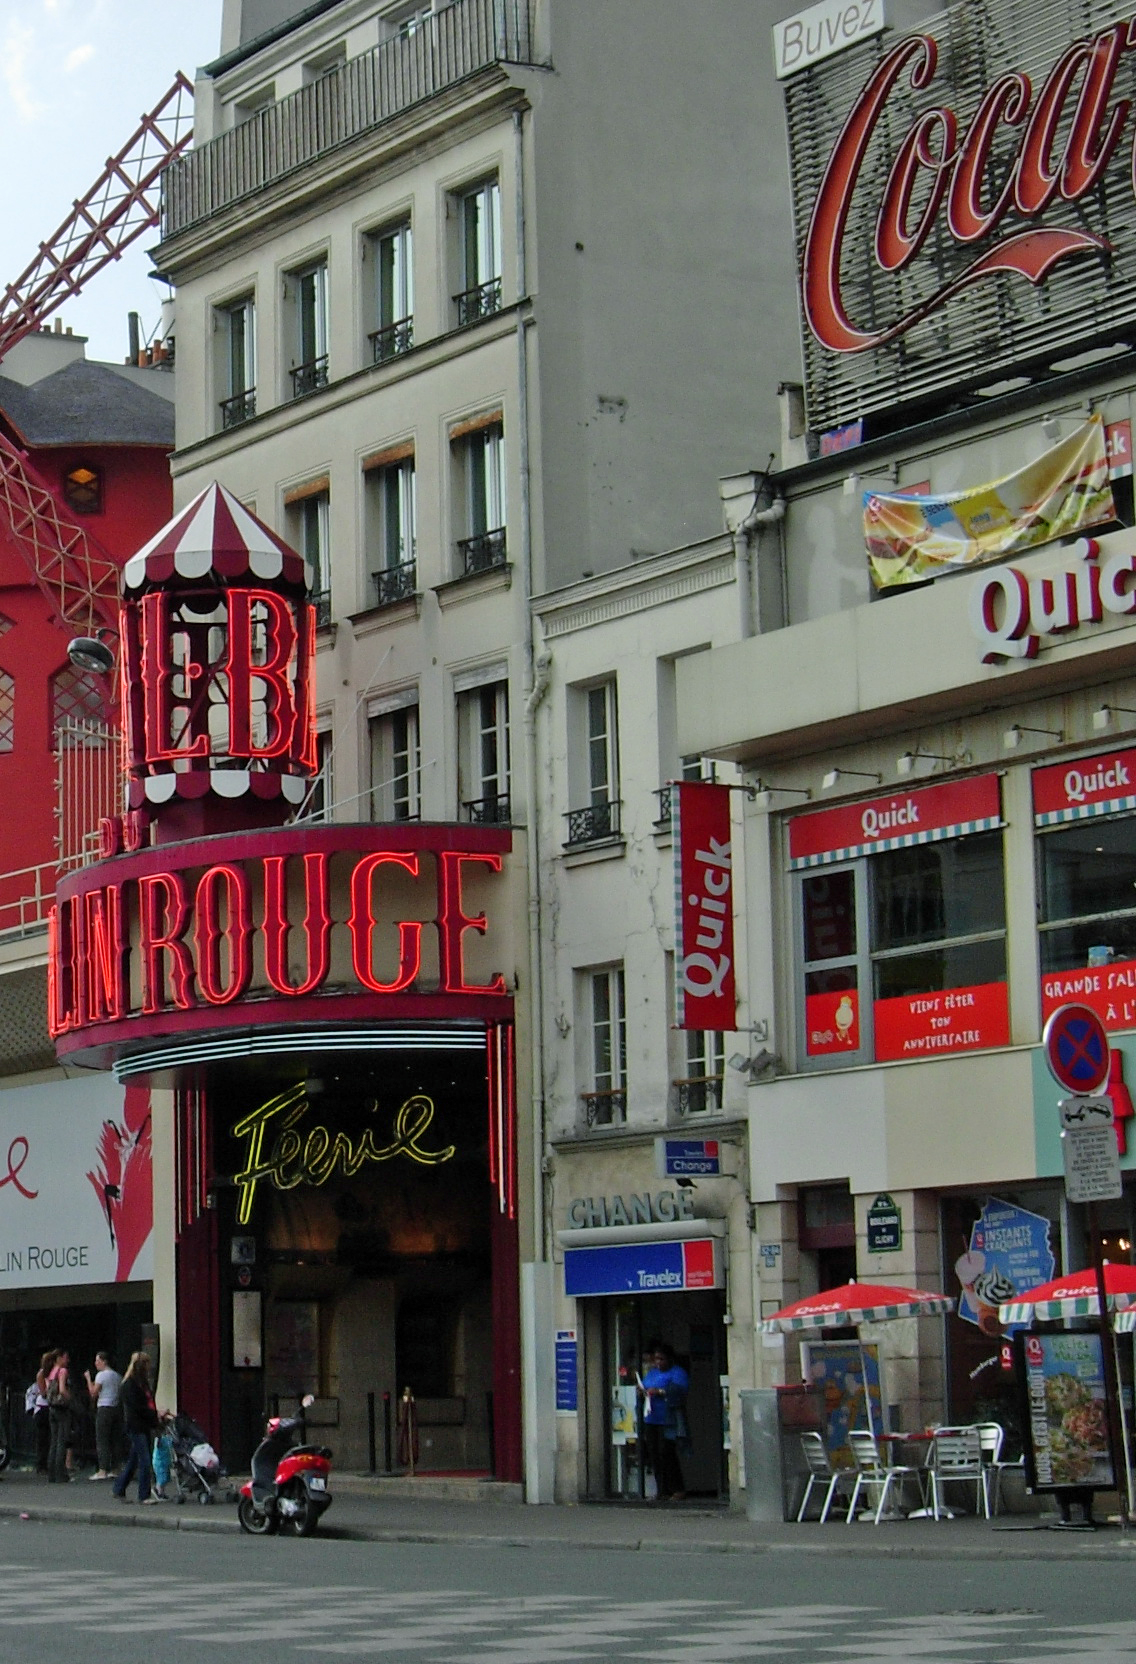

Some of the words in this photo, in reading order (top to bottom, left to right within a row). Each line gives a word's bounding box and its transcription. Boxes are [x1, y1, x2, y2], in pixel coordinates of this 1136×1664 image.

[781, 0, 876, 69] Buvez
[1064, 760, 1130, 802] Quick
[861, 799, 919, 838] Quick
[682, 836, 732, 998] Quick
[139, 851, 506, 1012] ROUGE
[1045, 975, 1100, 998] GRANDE
[910, 997, 942, 1014] VIENS
[931, 1016, 951, 1029] TON
[903, 1030, 980, 1050] ANNIVERSAIRE
[232, 1081, 456, 1224] Féerie
[673, 1160, 712, 1172] Change
[568, 1189, 695, 1229] CHANGE
[985, 1225, 1032, 1241] INSTANTS
[28, 1245, 89, 1271] ROUGE
[637, 1269, 682, 1288] Travelex
[795, 1302, 842, 1315] Quick
